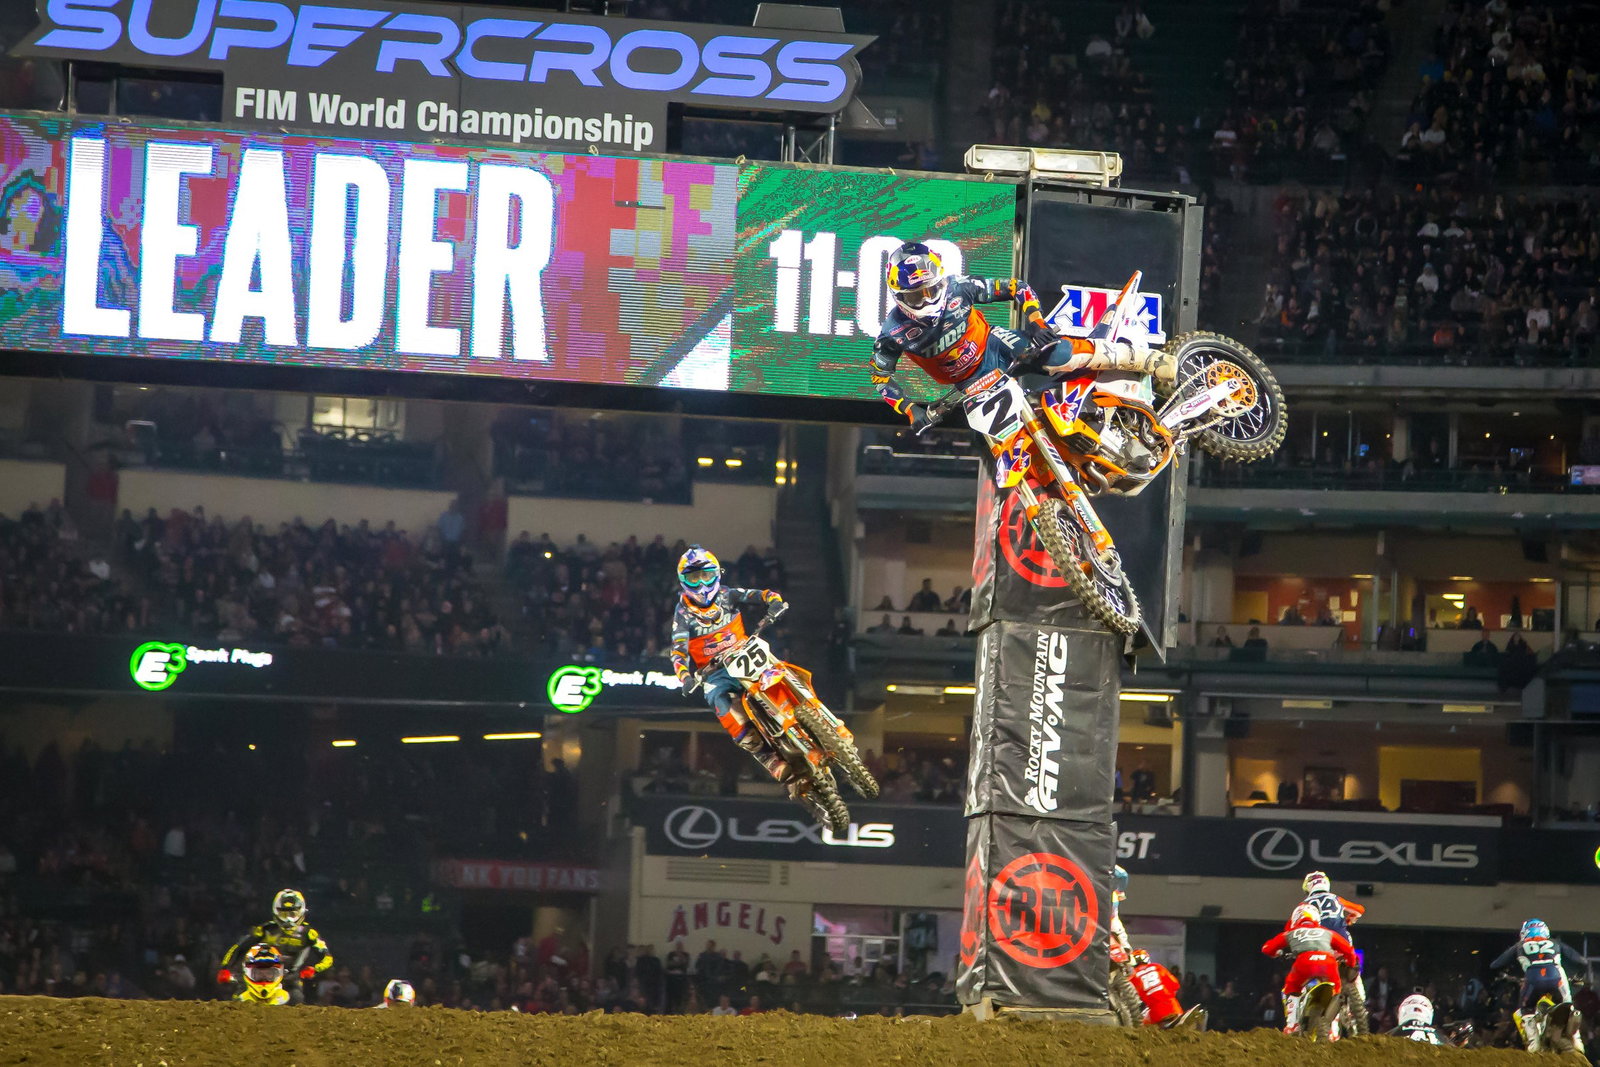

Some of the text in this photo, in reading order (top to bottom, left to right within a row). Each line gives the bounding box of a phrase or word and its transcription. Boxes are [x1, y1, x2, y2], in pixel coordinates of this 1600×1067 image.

[35, 0, 855, 103] SUPERCROSS
[235, 87, 654, 150] FIM World Championship
[62, 136, 556, 361] LEADER
[769, 229, 965, 337] 11:0
[982, 389, 1018, 436] 2
[186, 646, 230, 664] Spark
[230, 648, 273, 668] Plugs
[601, 668, 645, 687] Spark
[736, 643, 768, 678] 25
[1024, 630, 1050, 784] ROCKY MOUNTAIN
[728, 817, 895, 849] LEXUS
[1310, 838, 1480, 869] LEXUS
[667, 902, 787, 945] ANGELS
